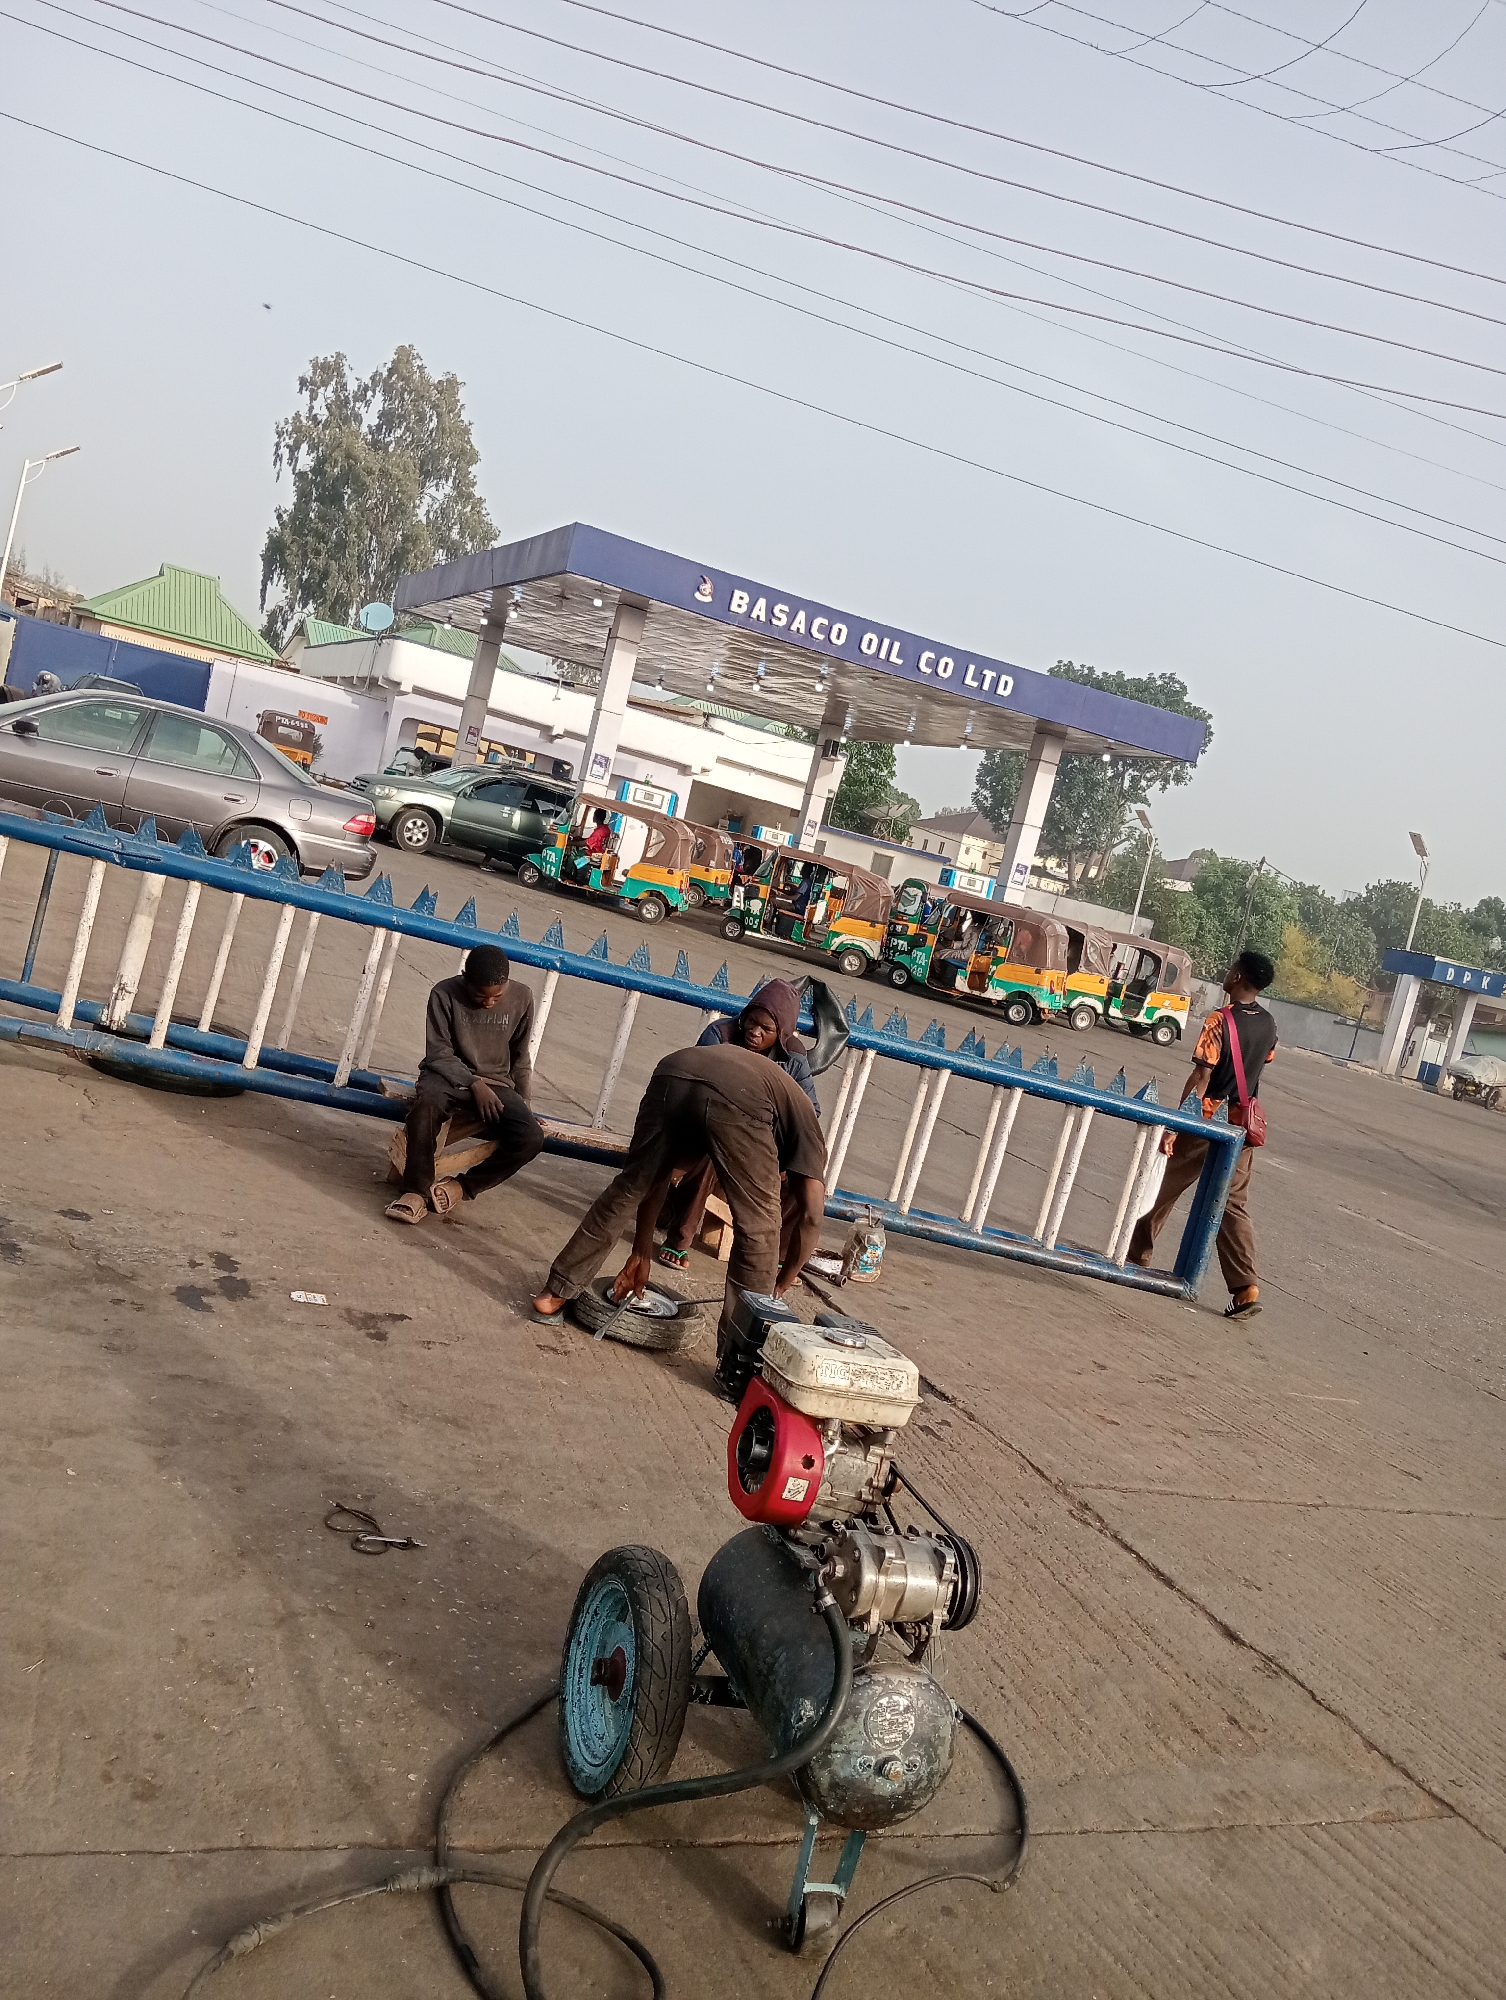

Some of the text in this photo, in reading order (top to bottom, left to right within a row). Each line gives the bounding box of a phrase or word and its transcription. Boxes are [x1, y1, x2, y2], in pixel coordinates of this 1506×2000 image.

[729, 589, 1014, 697] BASACO OIL CO LTD
